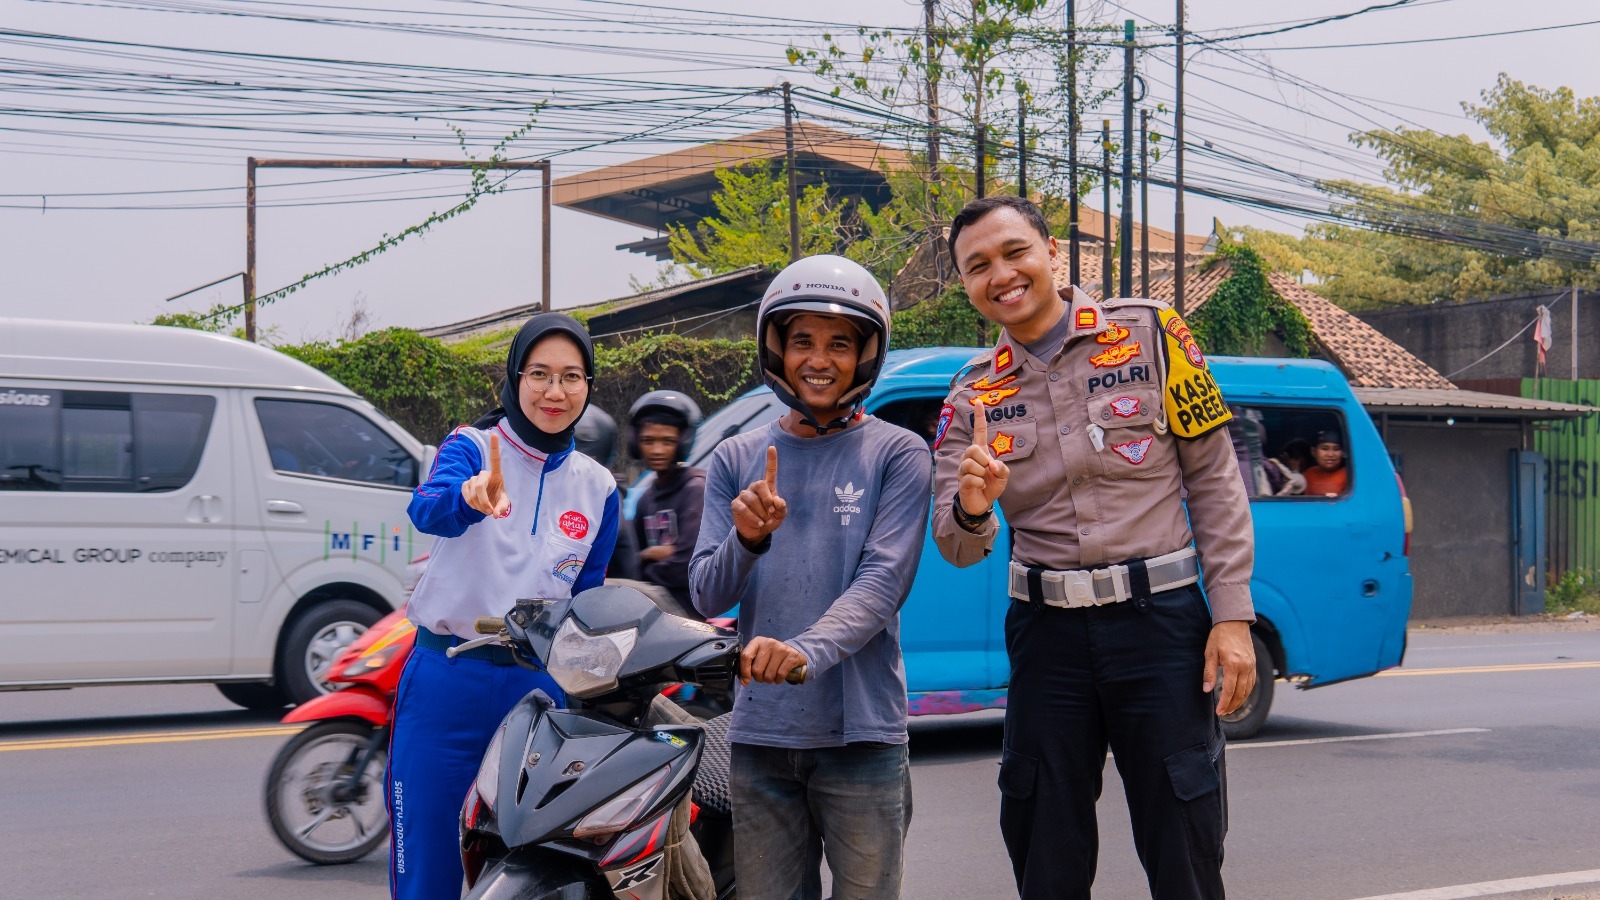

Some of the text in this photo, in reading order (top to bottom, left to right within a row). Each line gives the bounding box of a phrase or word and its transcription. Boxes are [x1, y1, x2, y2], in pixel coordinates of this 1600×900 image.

[805, 283, 846, 292] HONDA
[1088, 364, 1150, 394] POLRI
[1169, 369, 1217, 409] KASA
[0, 389, 51, 407] sions
[73, 547, 142, 563] GROUP
[148, 551, 229, 568] company
